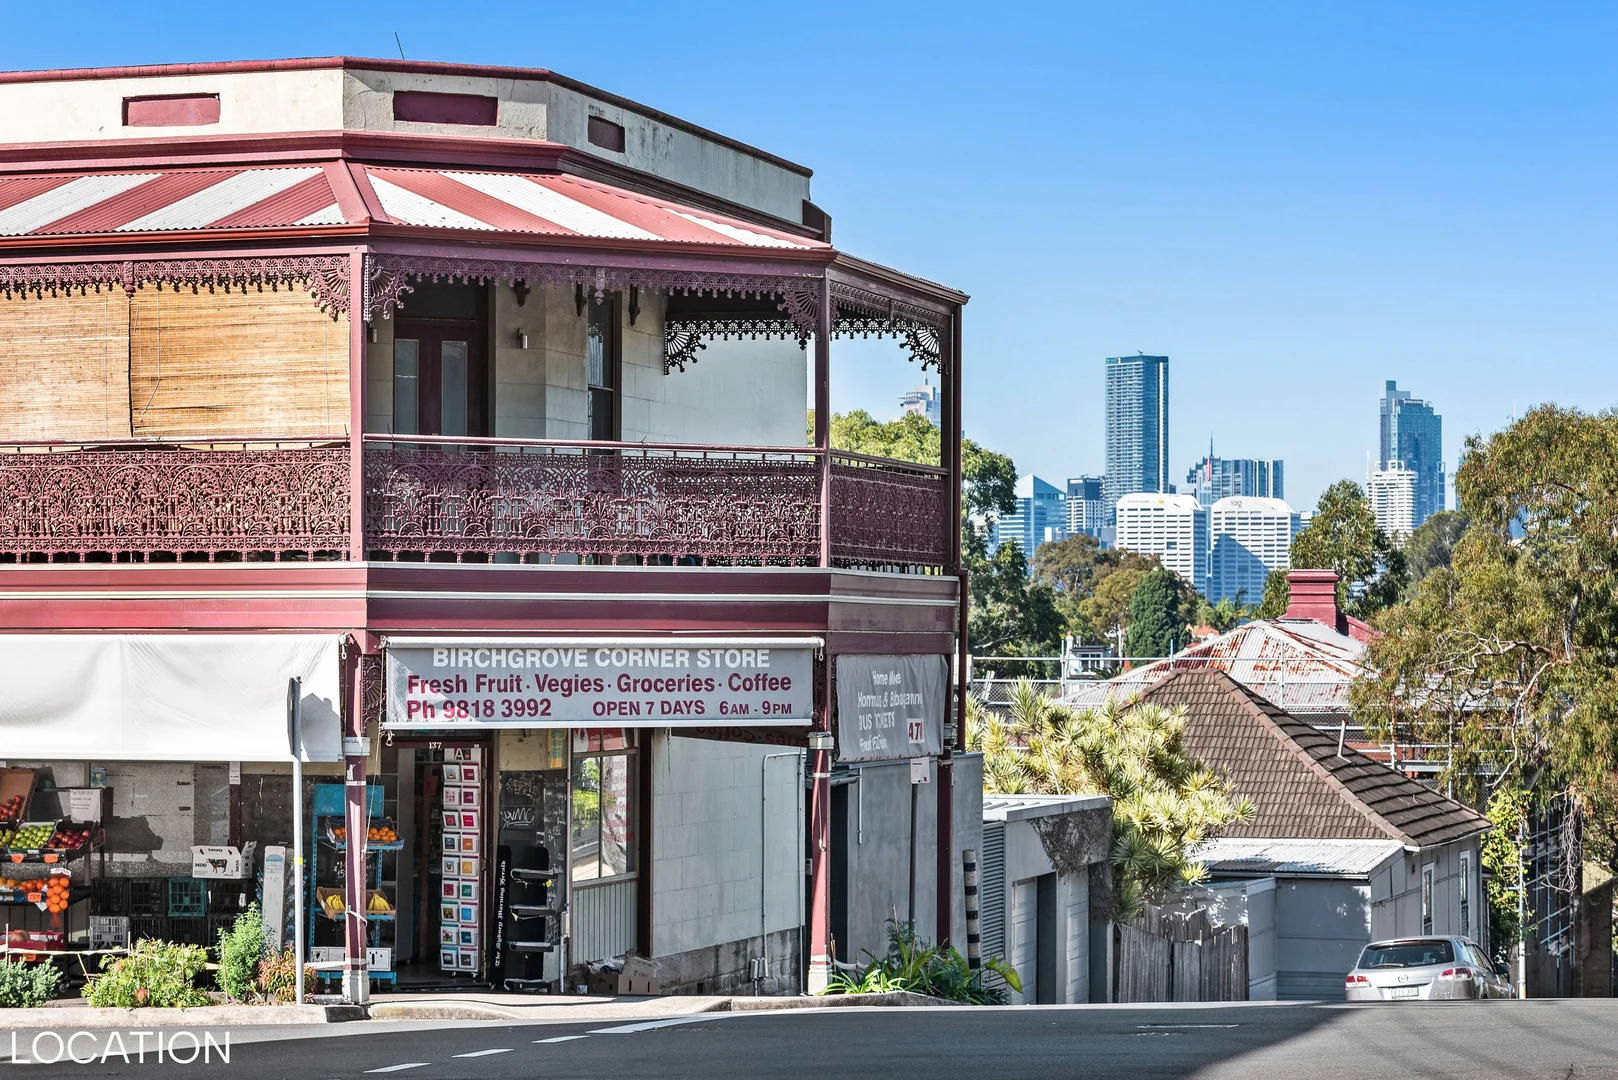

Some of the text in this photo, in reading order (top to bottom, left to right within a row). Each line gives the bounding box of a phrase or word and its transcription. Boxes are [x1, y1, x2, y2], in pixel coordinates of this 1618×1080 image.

[433, 648, 770, 668] BIRCHGROVE CORNER STORE
[407, 673, 792, 697] Fresh Fruit Vegies Groceries Coffee
[872, 670, 888, 686] Home
[407, 698, 552, 719] Ph 9818 3992
[592, 701, 641, 716] OPEN
[645, 701, 655, 715] 7
[660, 700, 705, 715] DAYS
[883, 691, 889, 707] &
[858, 713, 873, 731] BUS
[428, 741, 442, 749] 137
[498, 887, 506, 920] Morning
[496, 921, 504, 949] Sydney
